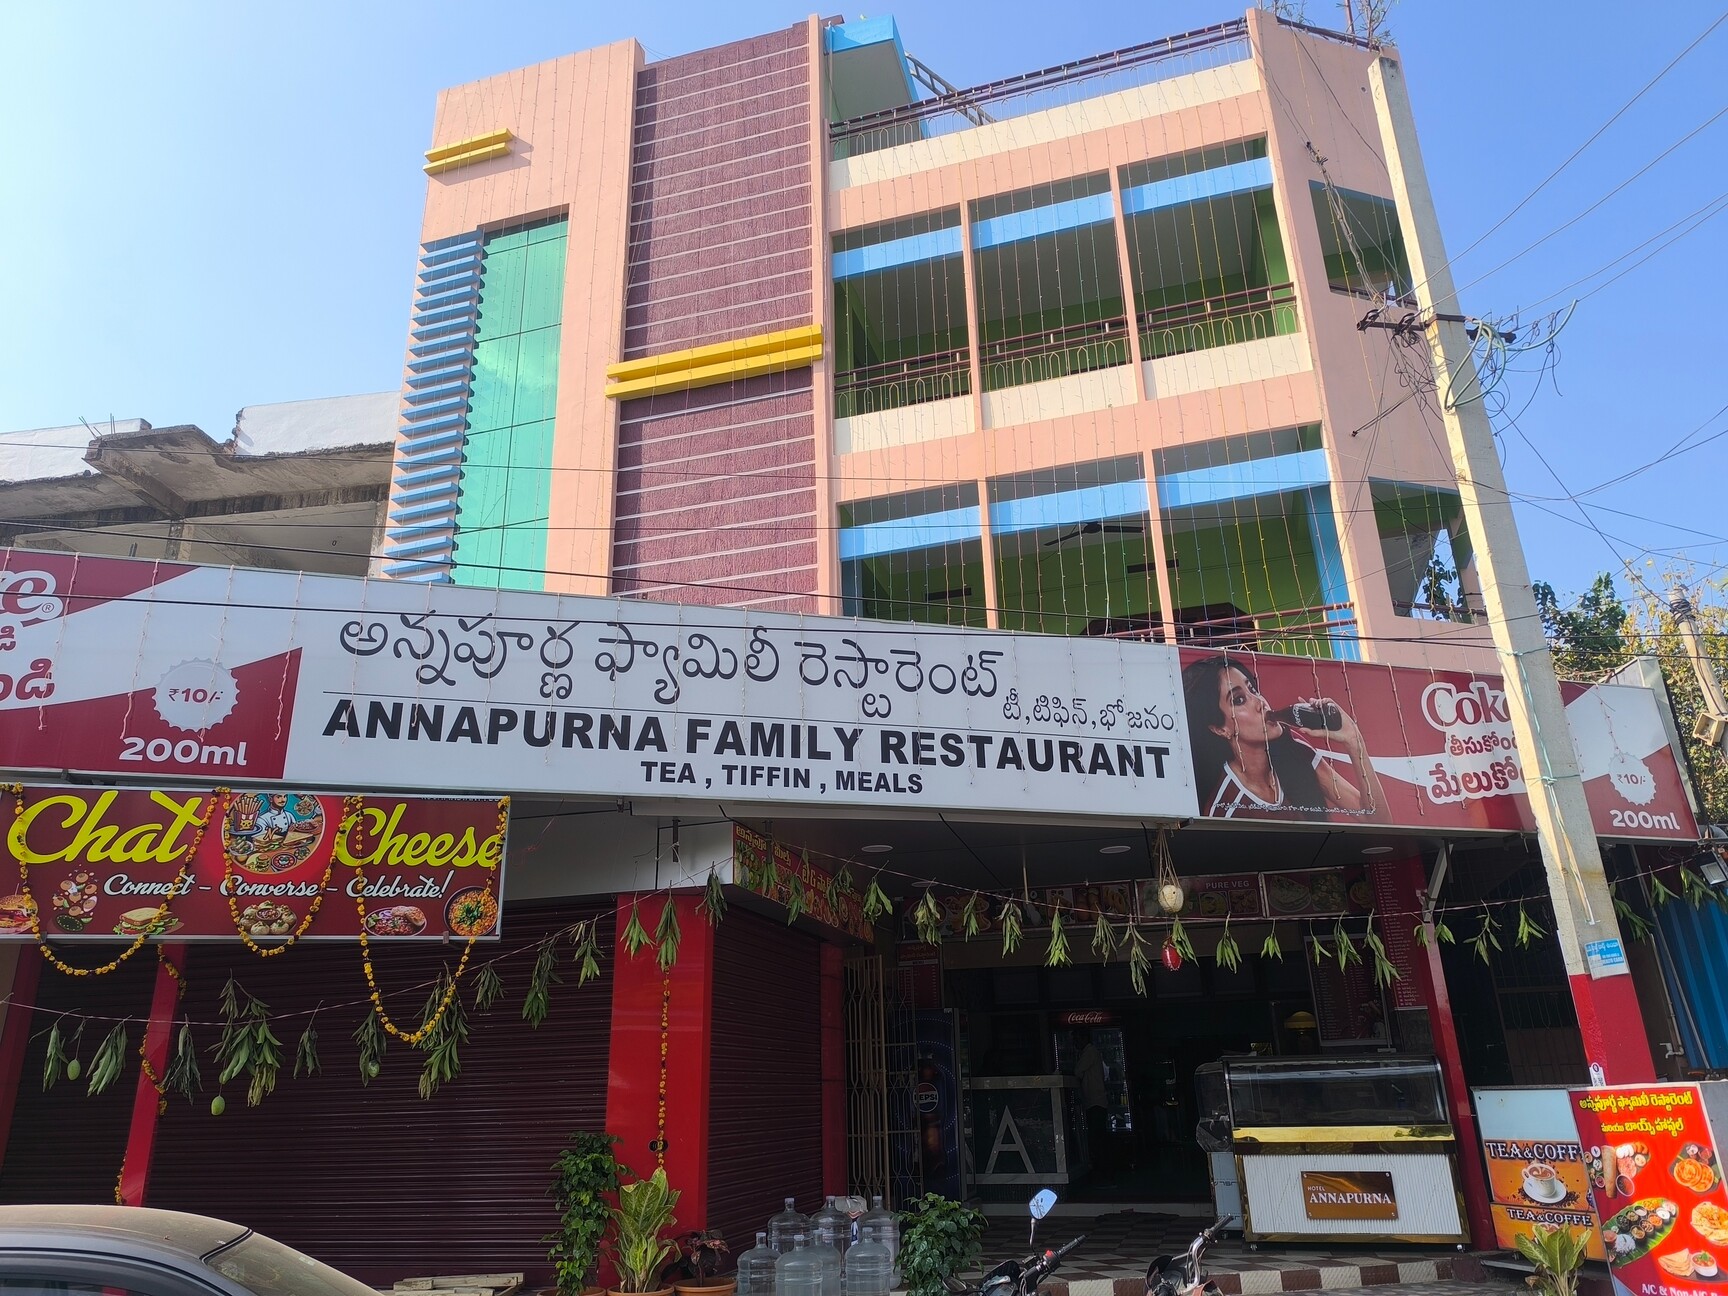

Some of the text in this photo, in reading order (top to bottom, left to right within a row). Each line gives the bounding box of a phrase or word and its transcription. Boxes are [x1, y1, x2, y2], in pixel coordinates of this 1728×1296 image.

[340, 610, 1004, 719] అన్నపూర్ణ ఫ్యామిలీ రెస్టారెంట్
[118, 737, 248, 766] 200ml
[322, 699, 1171, 780] ANNAPURNA FAMILY RESTAURANT
[1449, 731, 1518, 756] తీసుకోం
[641, 760, 697, 785] TEA
[721, 763, 811, 789] TIFFIN
[836, 770, 923, 794] MEALS
[7, 790, 503, 867] Chat Cheese
[1609, 809, 1681, 830] 200ml
[103, 873, 196, 896] Connect
[219, 875, 319, 897] Converse
[346, 869, 455, 899] Celebrate!
[1205, 880, 1250, 890] PURE VEG
[1309, 1192, 1392, 1205] ANNAPURNA
